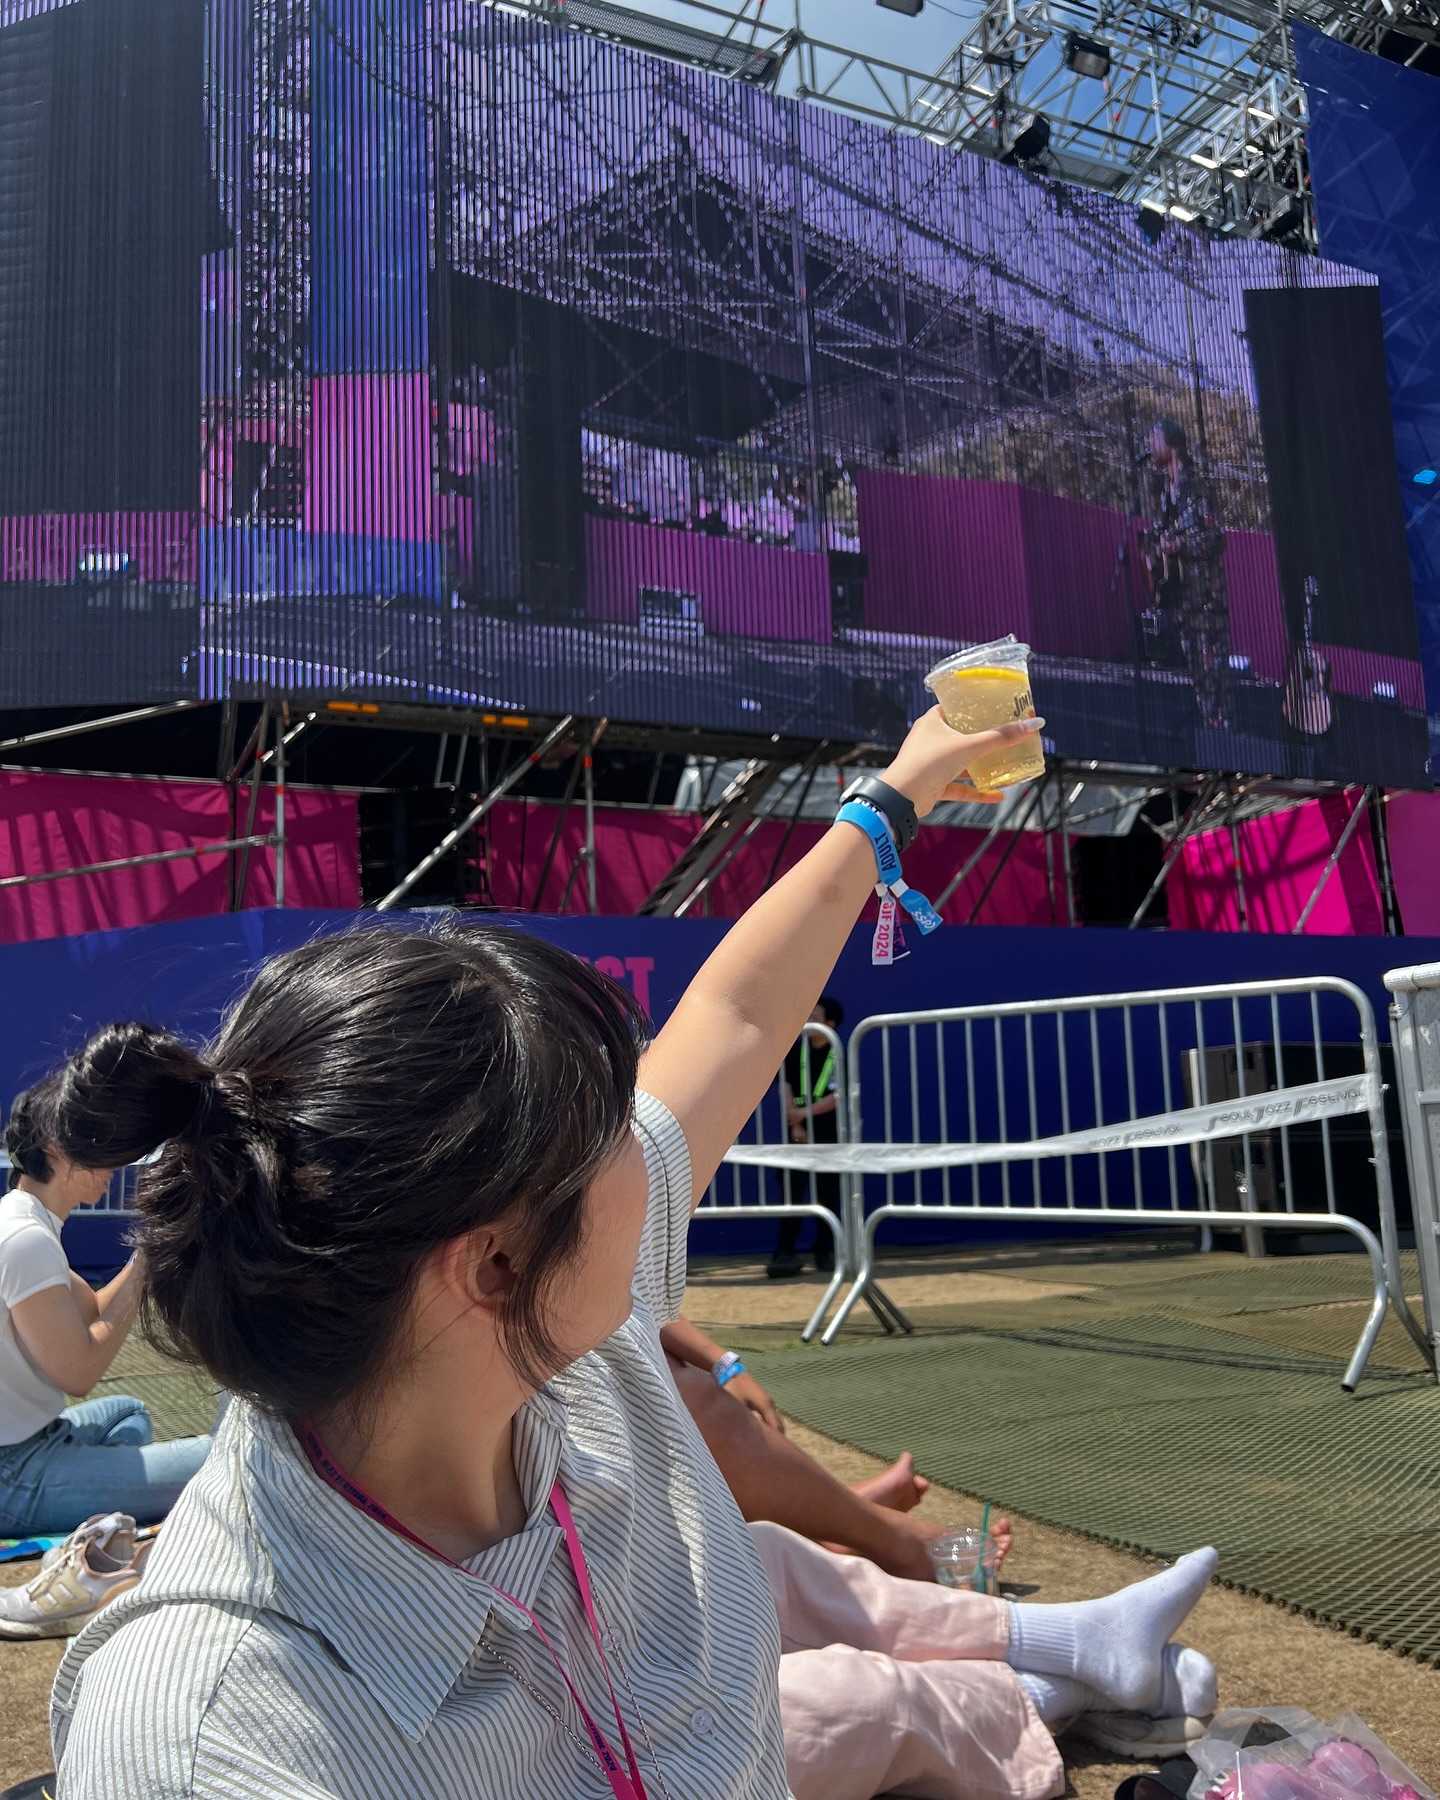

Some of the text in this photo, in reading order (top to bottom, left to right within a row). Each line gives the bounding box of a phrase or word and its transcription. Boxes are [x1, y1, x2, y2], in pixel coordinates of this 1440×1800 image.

[1013, 692, 1029, 717] JIM
[874, 832, 897, 872] ADULT
[875, 902, 894, 958] SJF 2024
[1201, 1112, 1254, 1133] Seoul
[1251, 1101, 1294, 1124] Jazz
[601, 1750, 617, 1772] 2024
